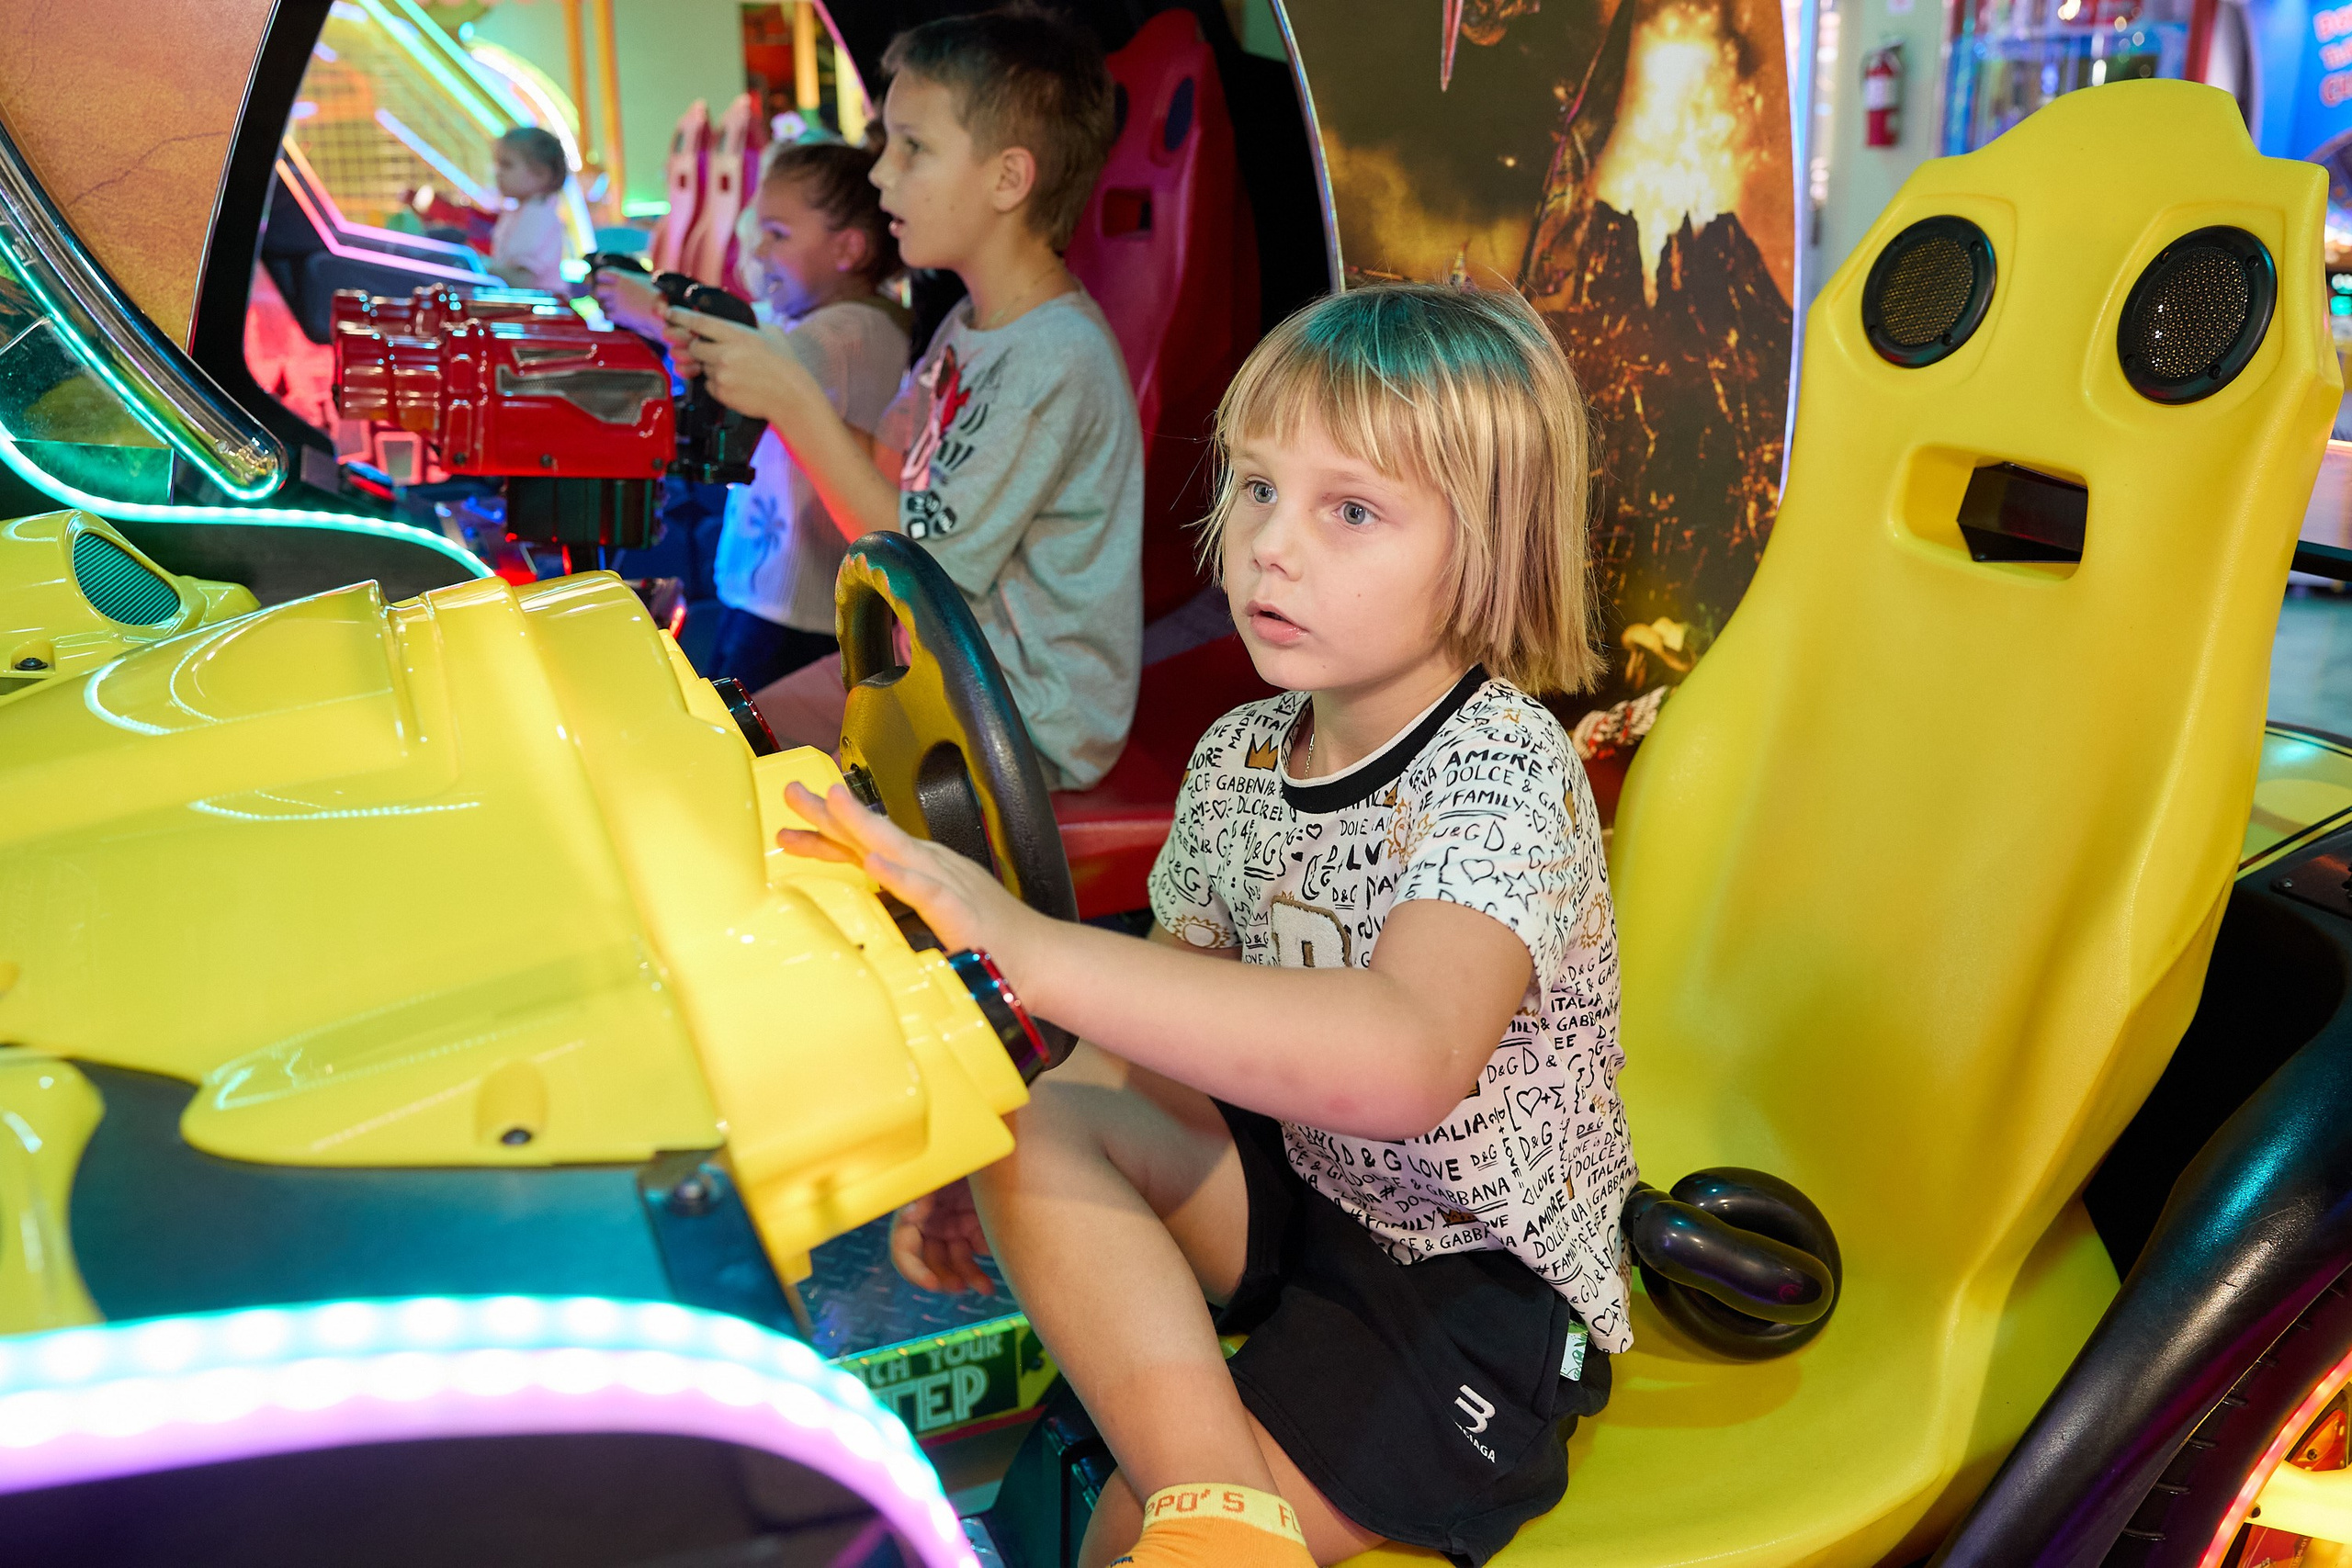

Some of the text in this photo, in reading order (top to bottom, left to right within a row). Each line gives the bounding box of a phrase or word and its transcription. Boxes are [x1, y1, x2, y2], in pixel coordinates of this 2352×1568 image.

[1443, 750, 1543, 782] AMORE
[1446, 764, 1514, 787] DOLCE
[1551, 992, 1603, 1012] ITALIA
[1487, 1056, 1519, 1084] D&G
[1470, 1144, 1498, 1167] D&G
[1519, 1121, 1553, 1162] D&G
[1567, 1139, 1590, 1163] LOVE
[1408, 1154, 1463, 1181] LOVE
[1576, 1145, 1616, 1179] DOLCE
[1588, 1155, 1628, 1188] ITALIA
[1427, 1177, 1510, 1206] GABBANA
[1535, 1165, 1555, 1199] LOVE
[1523, 1189, 1567, 1243] AMORE
[927, 1334, 1002, 1371] YOUR
[873, 1365, 987, 1430] TEP
